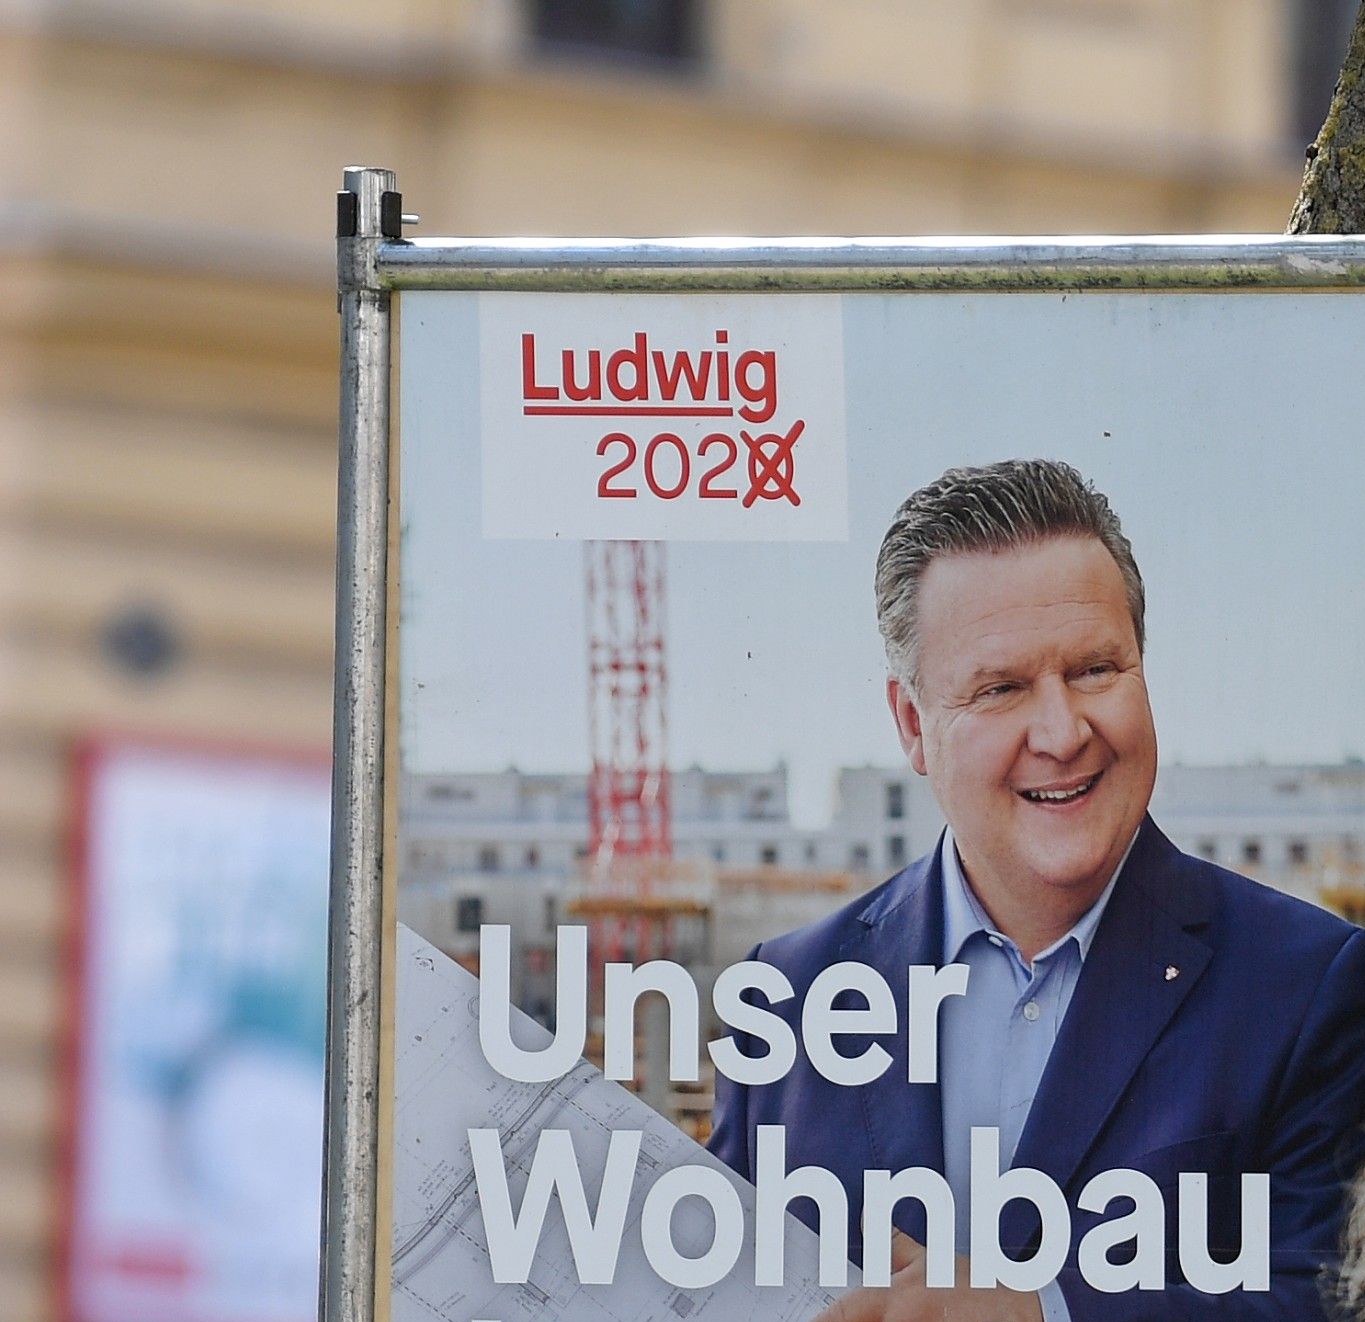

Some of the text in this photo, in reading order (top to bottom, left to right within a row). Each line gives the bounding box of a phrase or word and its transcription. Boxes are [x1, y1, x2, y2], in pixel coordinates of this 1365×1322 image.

[521, 330, 778, 423] Ludwig
[478, 924, 970, 1085] Unser
[468, 1125, 1270, 1293] Wohnbau
